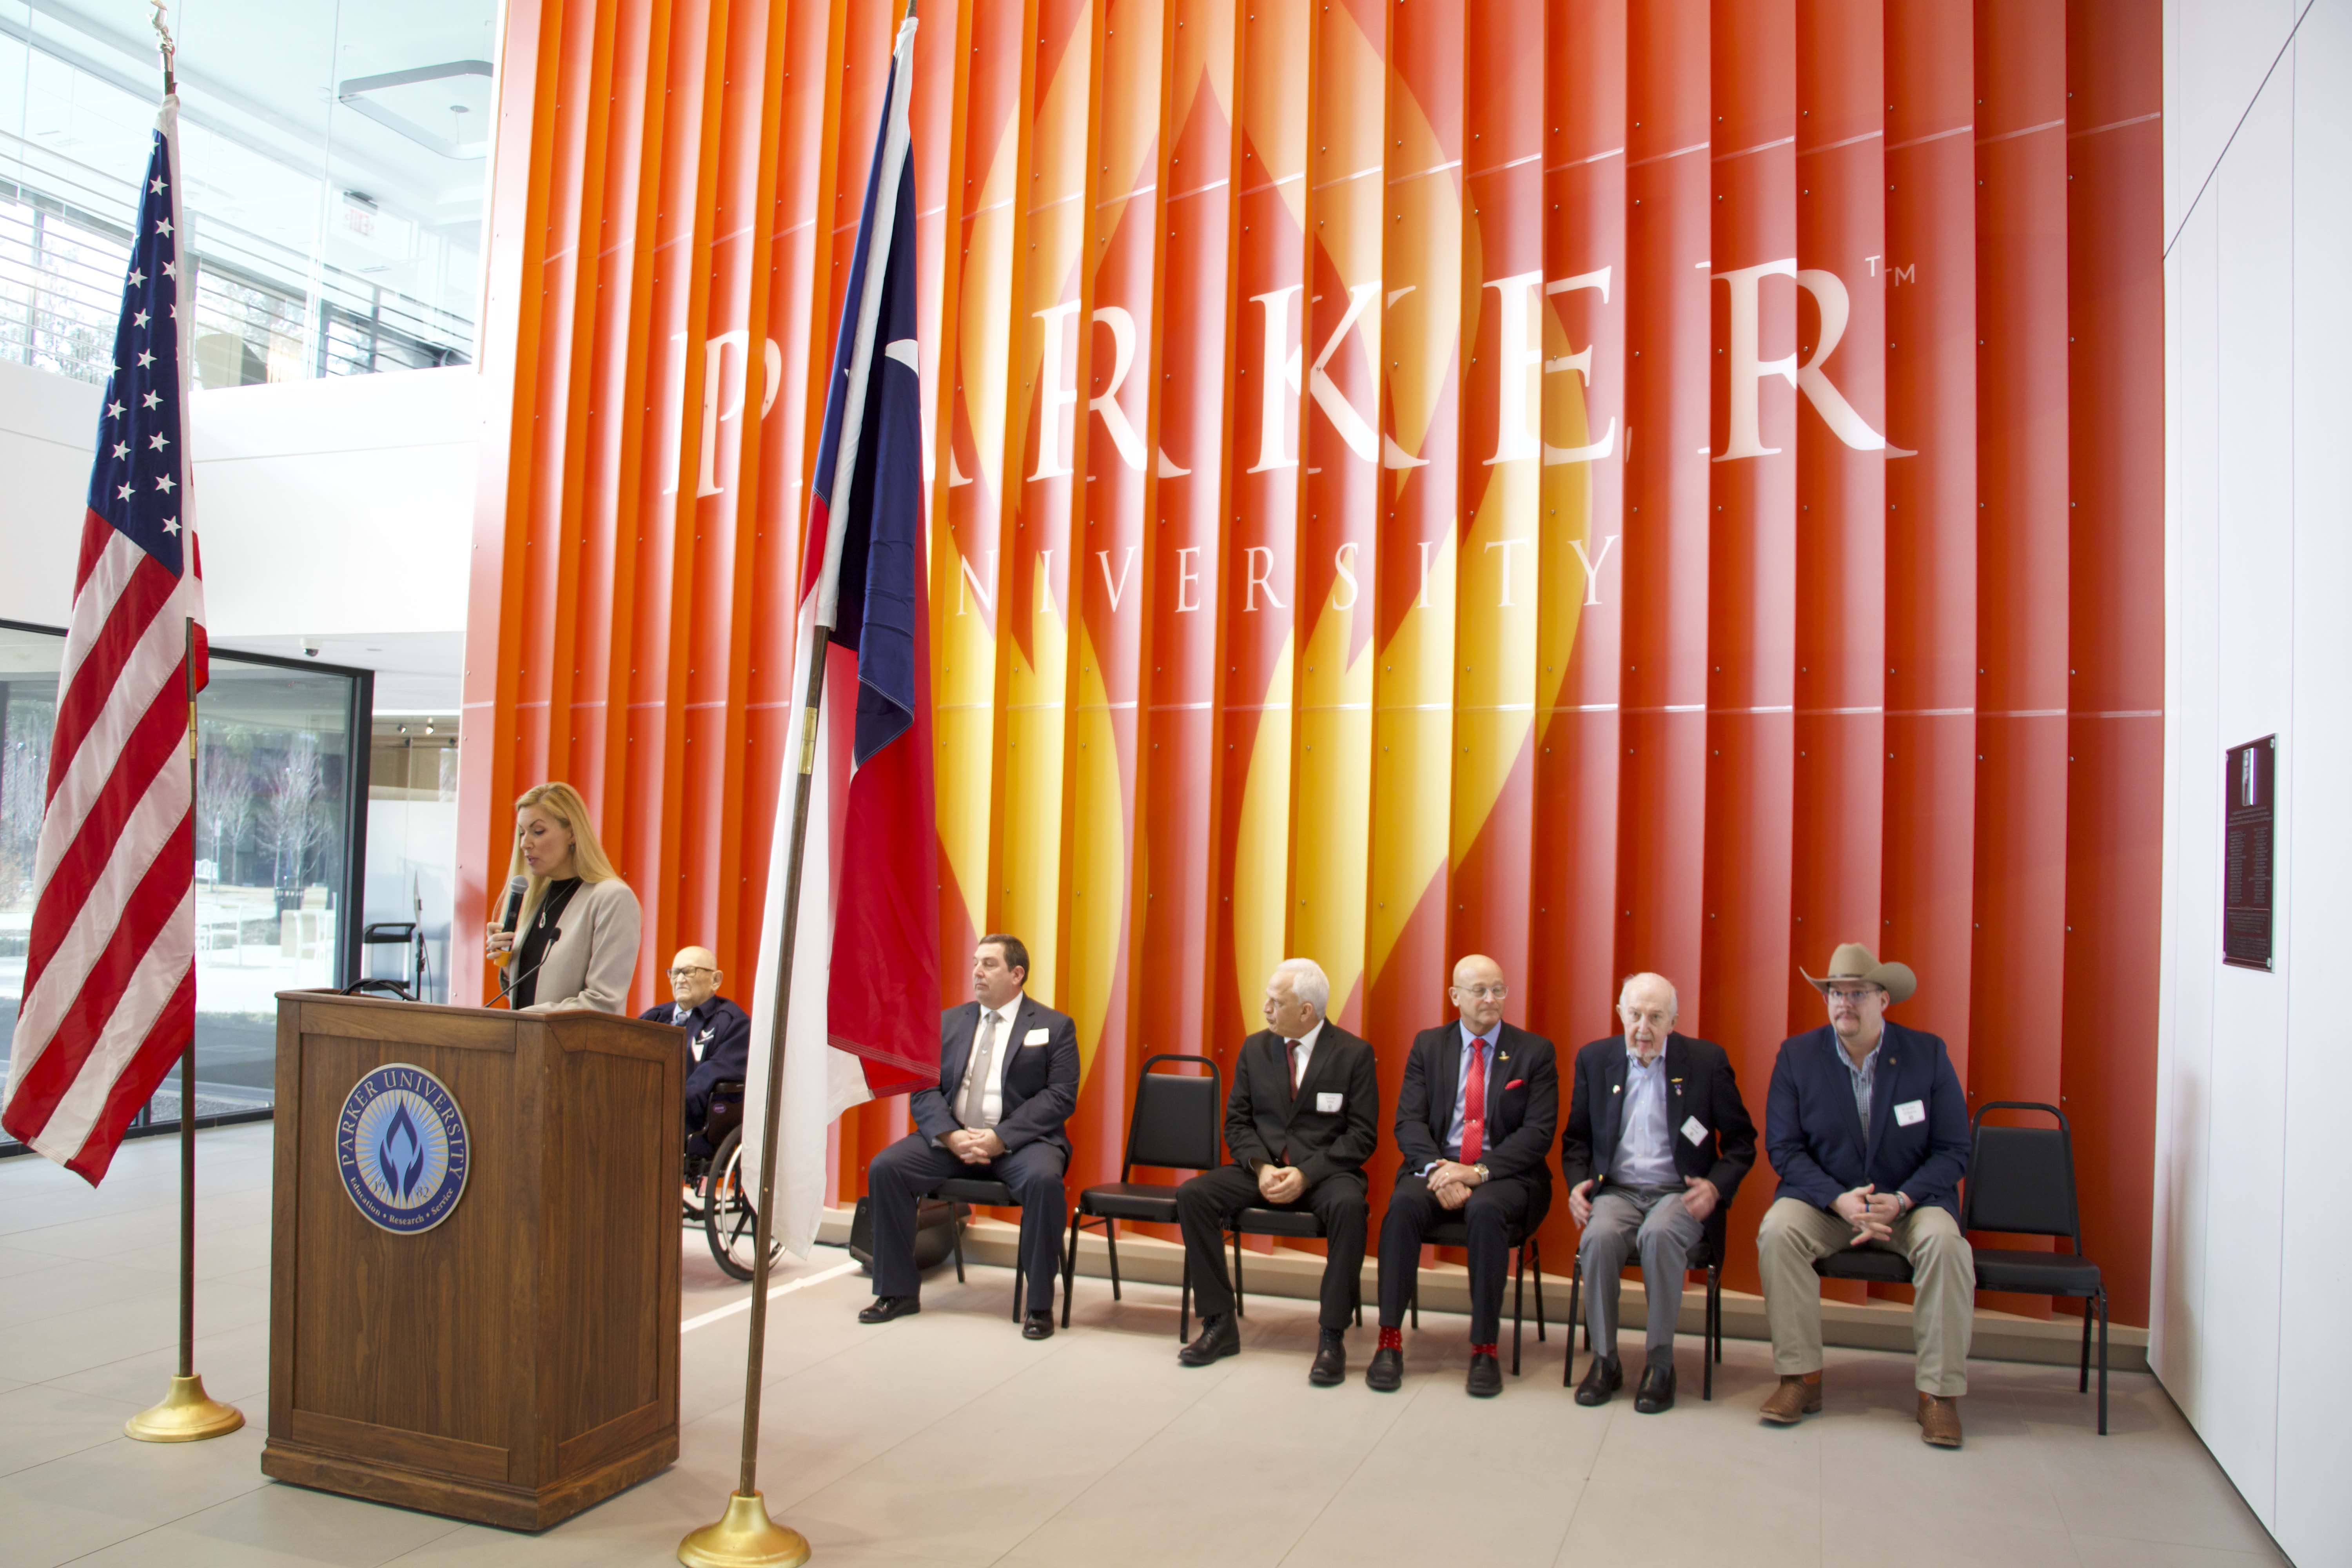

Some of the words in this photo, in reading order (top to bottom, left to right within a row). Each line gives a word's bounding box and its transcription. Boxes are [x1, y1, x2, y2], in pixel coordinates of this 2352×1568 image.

[662, 258, 1918, 499] PRKER
[955, 534, 1621, 617] NIVERSITY
[341, 1080, 379, 1167] PARKER
[383, 1070, 465, 1181] UNIVERSITY
[350, 1176, 381, 1216] Education
[389, 1214, 425, 1225] Research
[431, 1187, 454, 1215] Service
